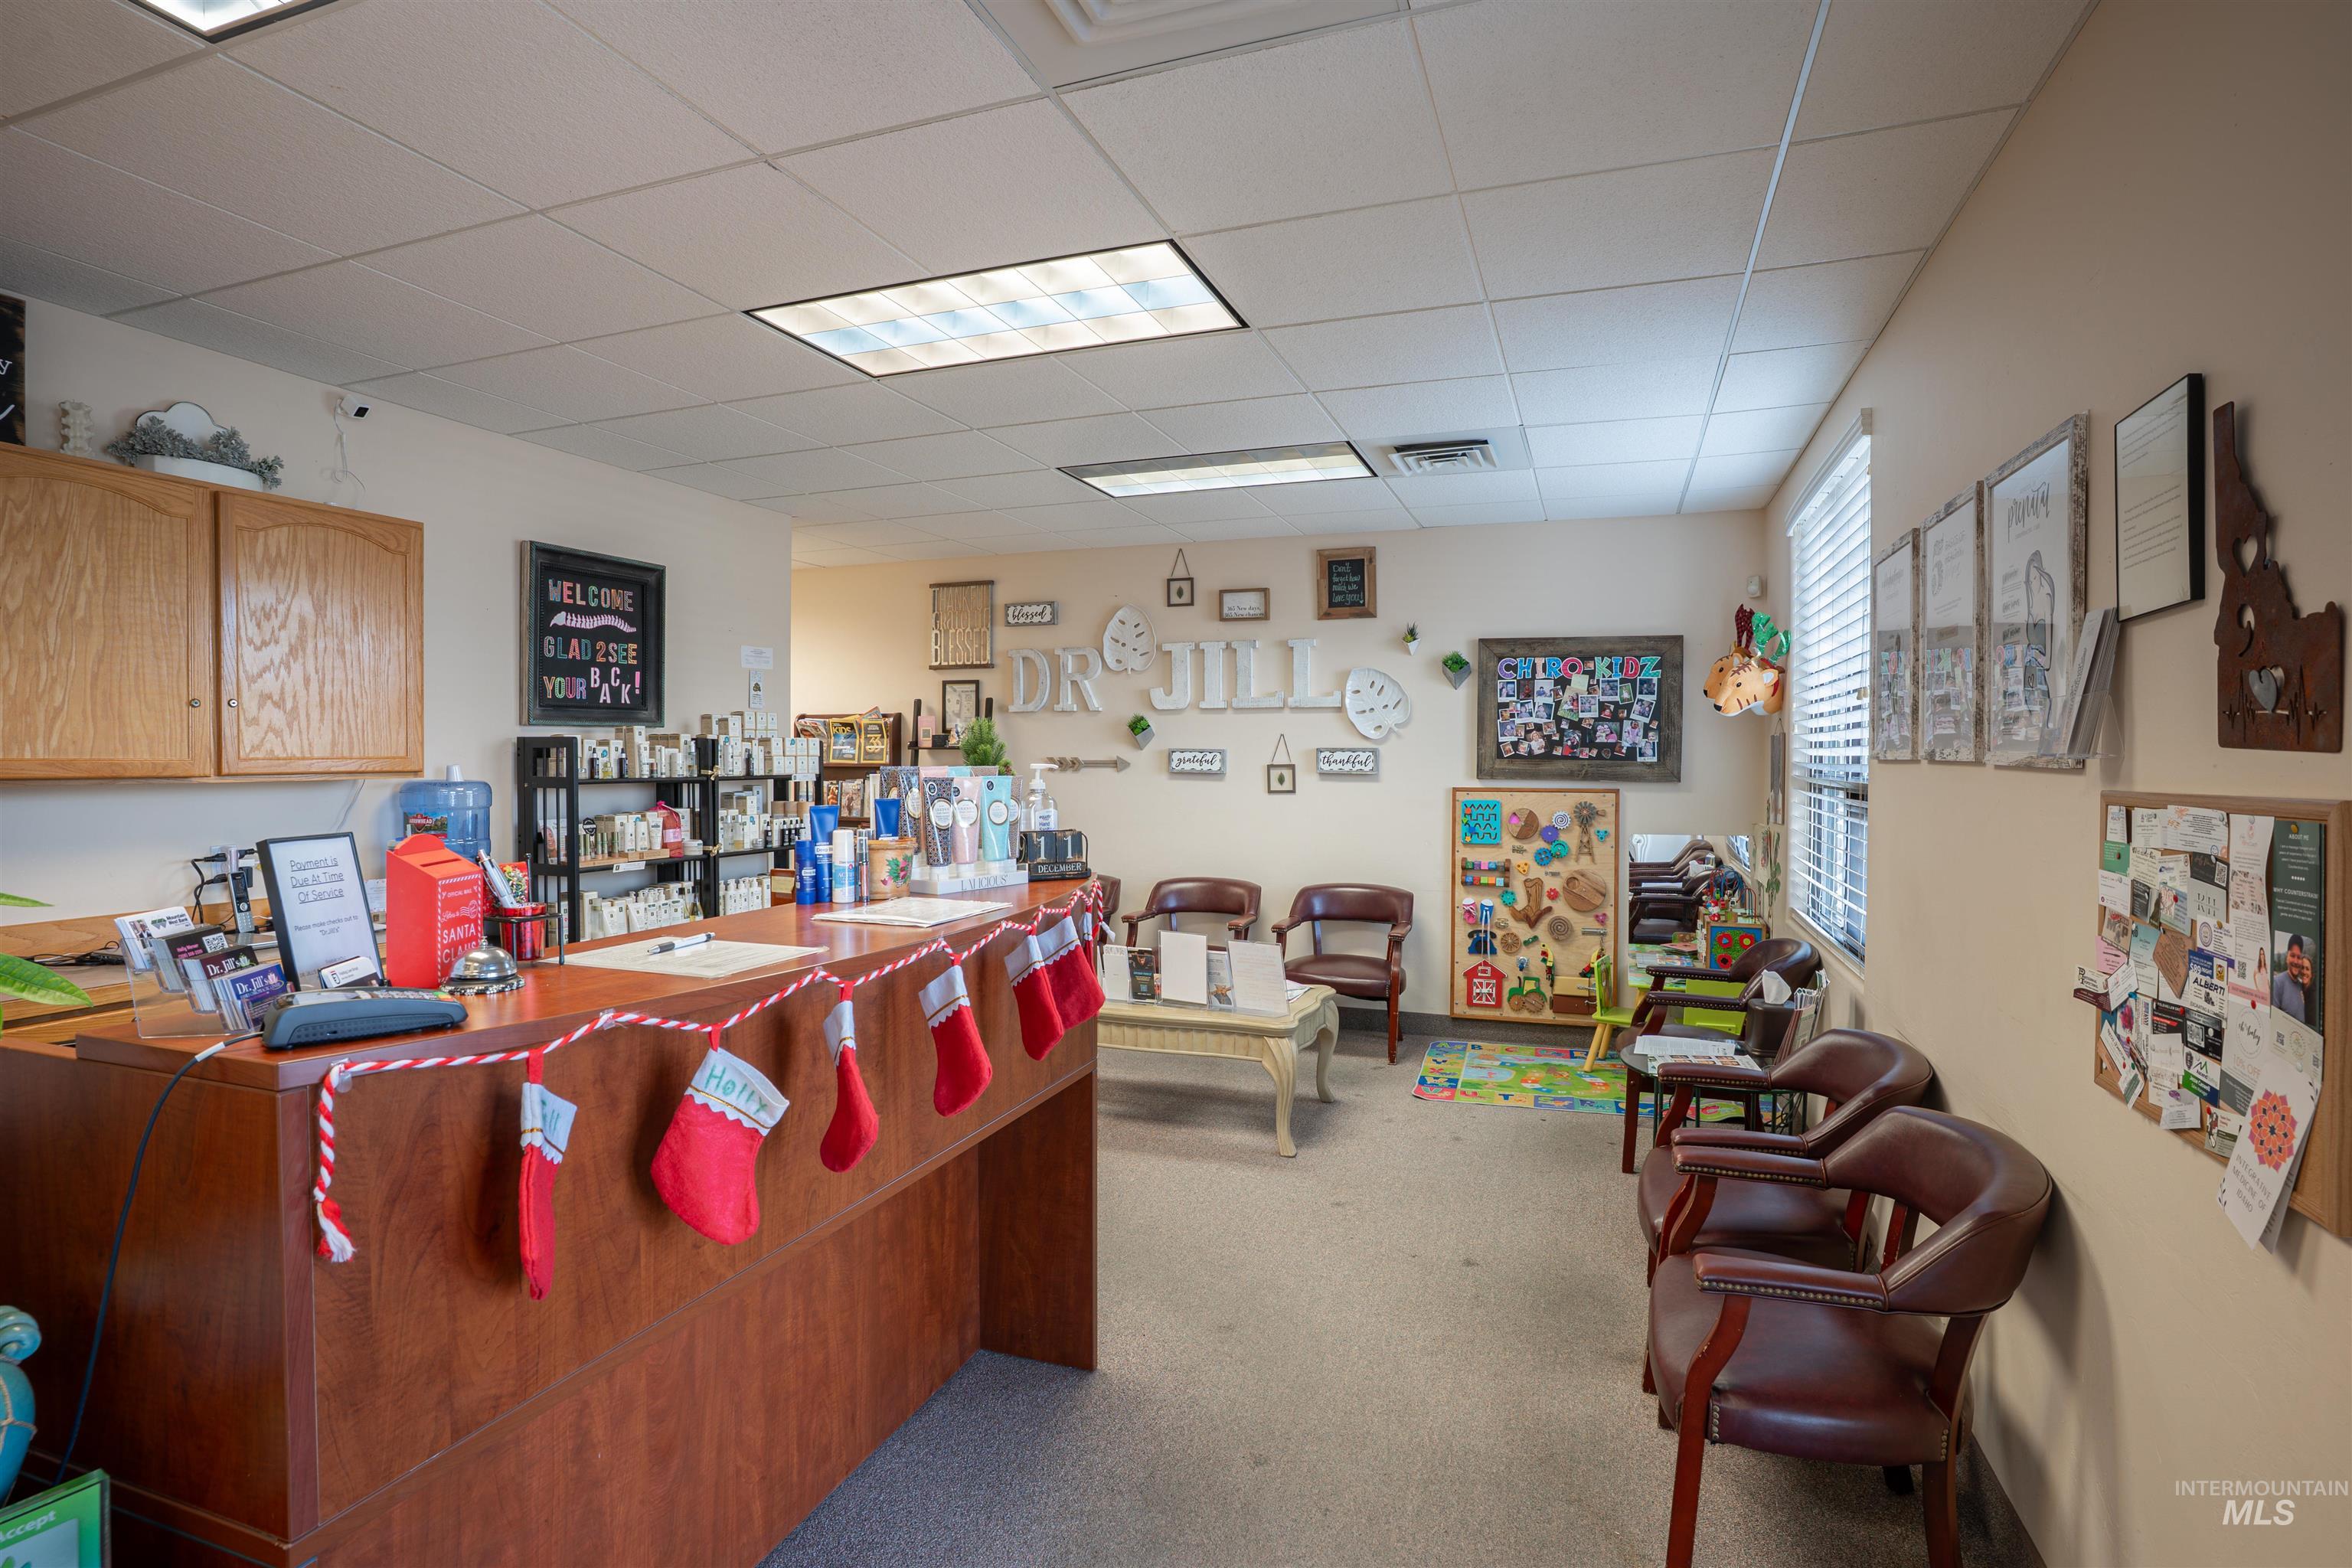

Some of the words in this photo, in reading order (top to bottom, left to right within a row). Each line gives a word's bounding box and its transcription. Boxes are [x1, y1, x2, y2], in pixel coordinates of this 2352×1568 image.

[1333, 562, 1352, 573] Don't
[1332, 573, 1348, 585] forget
[1349, 573, 1361, 582] how
[1332, 583, 1348, 593] much
[548, 579, 634, 612] WELCOME
[1332, 593, 1345, 603] love
[1012, 606, 1047, 621] blessed
[544, 636, 591, 660] GLAD
[931, 628, 990, 665] BLESSED
[1007, 646, 1103, 713] DR
[1149, 638, 1343, 710] JILL
[1498, 657, 1584, 679] CHIRO
[1594, 656, 1662, 679] KIDZ
[543, 676, 586, 699] YOUR
[1174, 753, 1217, 767] grateful
[1321, 753, 1371, 767] thankful
[289, 858, 328, 871] Payment
[330, 856, 338, 867] is
[1038, 862, 1082, 874] DECEMBER
[290, 876, 310, 887] Due
[312, 874, 322, 884] At
[323, 871, 345, 882] Time
[298, 891, 310, 903] Of
[312, 887, 344, 900] Service
[443, 923, 476, 943] SANTA
[207, 964, 224, 976] Dr.
[224, 957, 240, 973] Jill's
[236, 982, 253, 995] Dr.
[253, 976, 269, 993] Jill's
[705, 1063, 769, 1116] Holly
[2236, 1154, 2272, 1201] INTEGRATIVE
[2233, 1165, 2259, 1200] MEDICINE
[2258, 1200, 2268, 1211] OF
[2236, 1188, 2254, 1213] IDAHO
